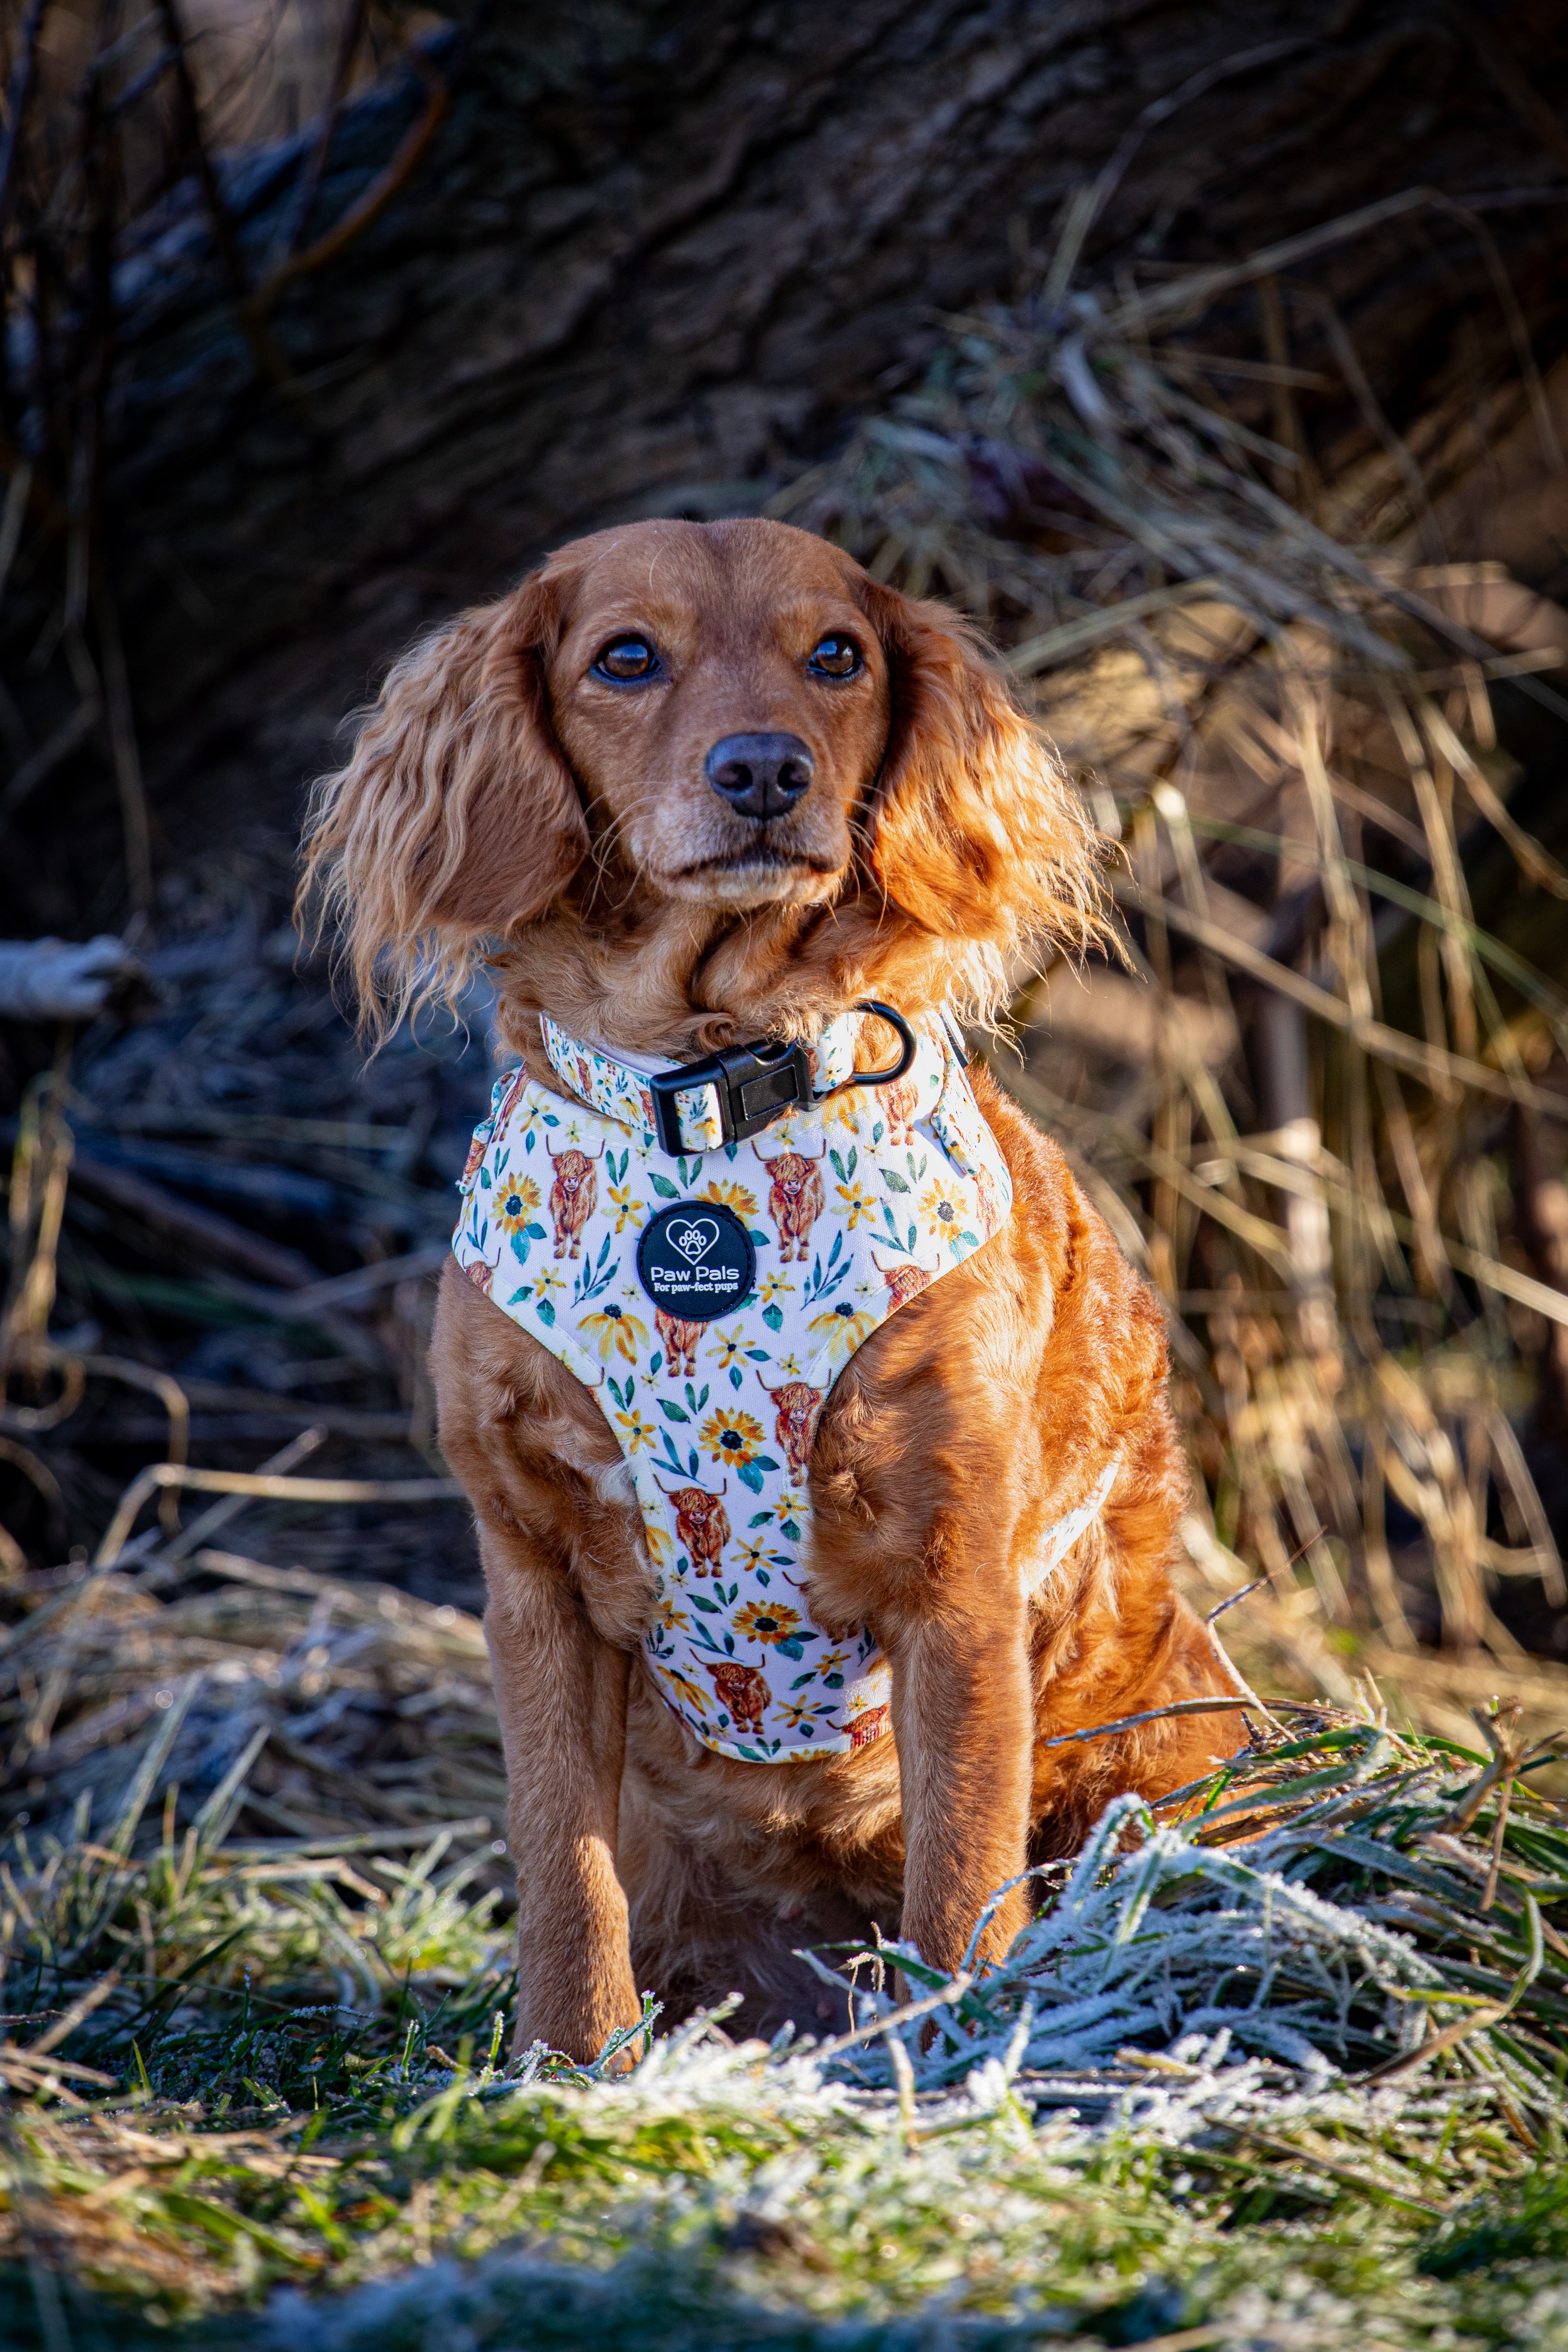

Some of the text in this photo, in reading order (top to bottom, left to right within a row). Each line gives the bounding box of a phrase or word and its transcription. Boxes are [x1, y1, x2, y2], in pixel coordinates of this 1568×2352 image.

[651, 1266, 739, 1281] Paw Pals
[654, 1282, 738, 1294] For paw-fect pups
